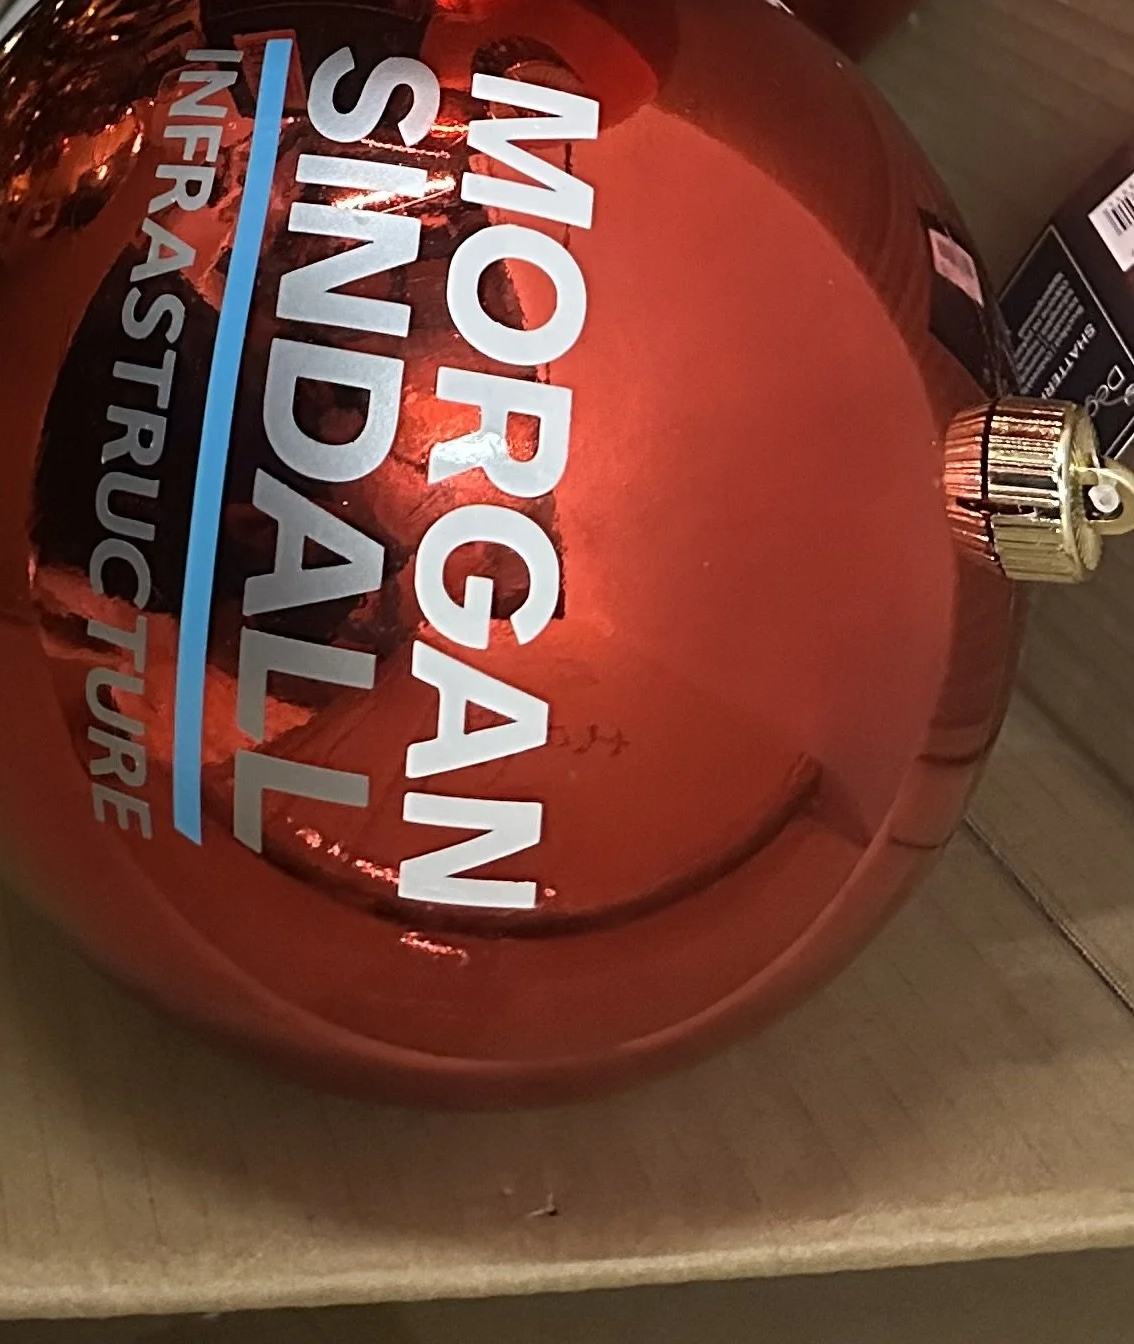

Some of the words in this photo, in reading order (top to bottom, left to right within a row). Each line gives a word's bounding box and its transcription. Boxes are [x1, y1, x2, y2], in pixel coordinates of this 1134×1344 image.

[83, 48, 245, 841] INFRASTRUCTURE
[232, 45, 442, 853] SINDALL
[398, 72, 601, 910] MORGAN
[1041, 322, 1097, 400] SHATTER
